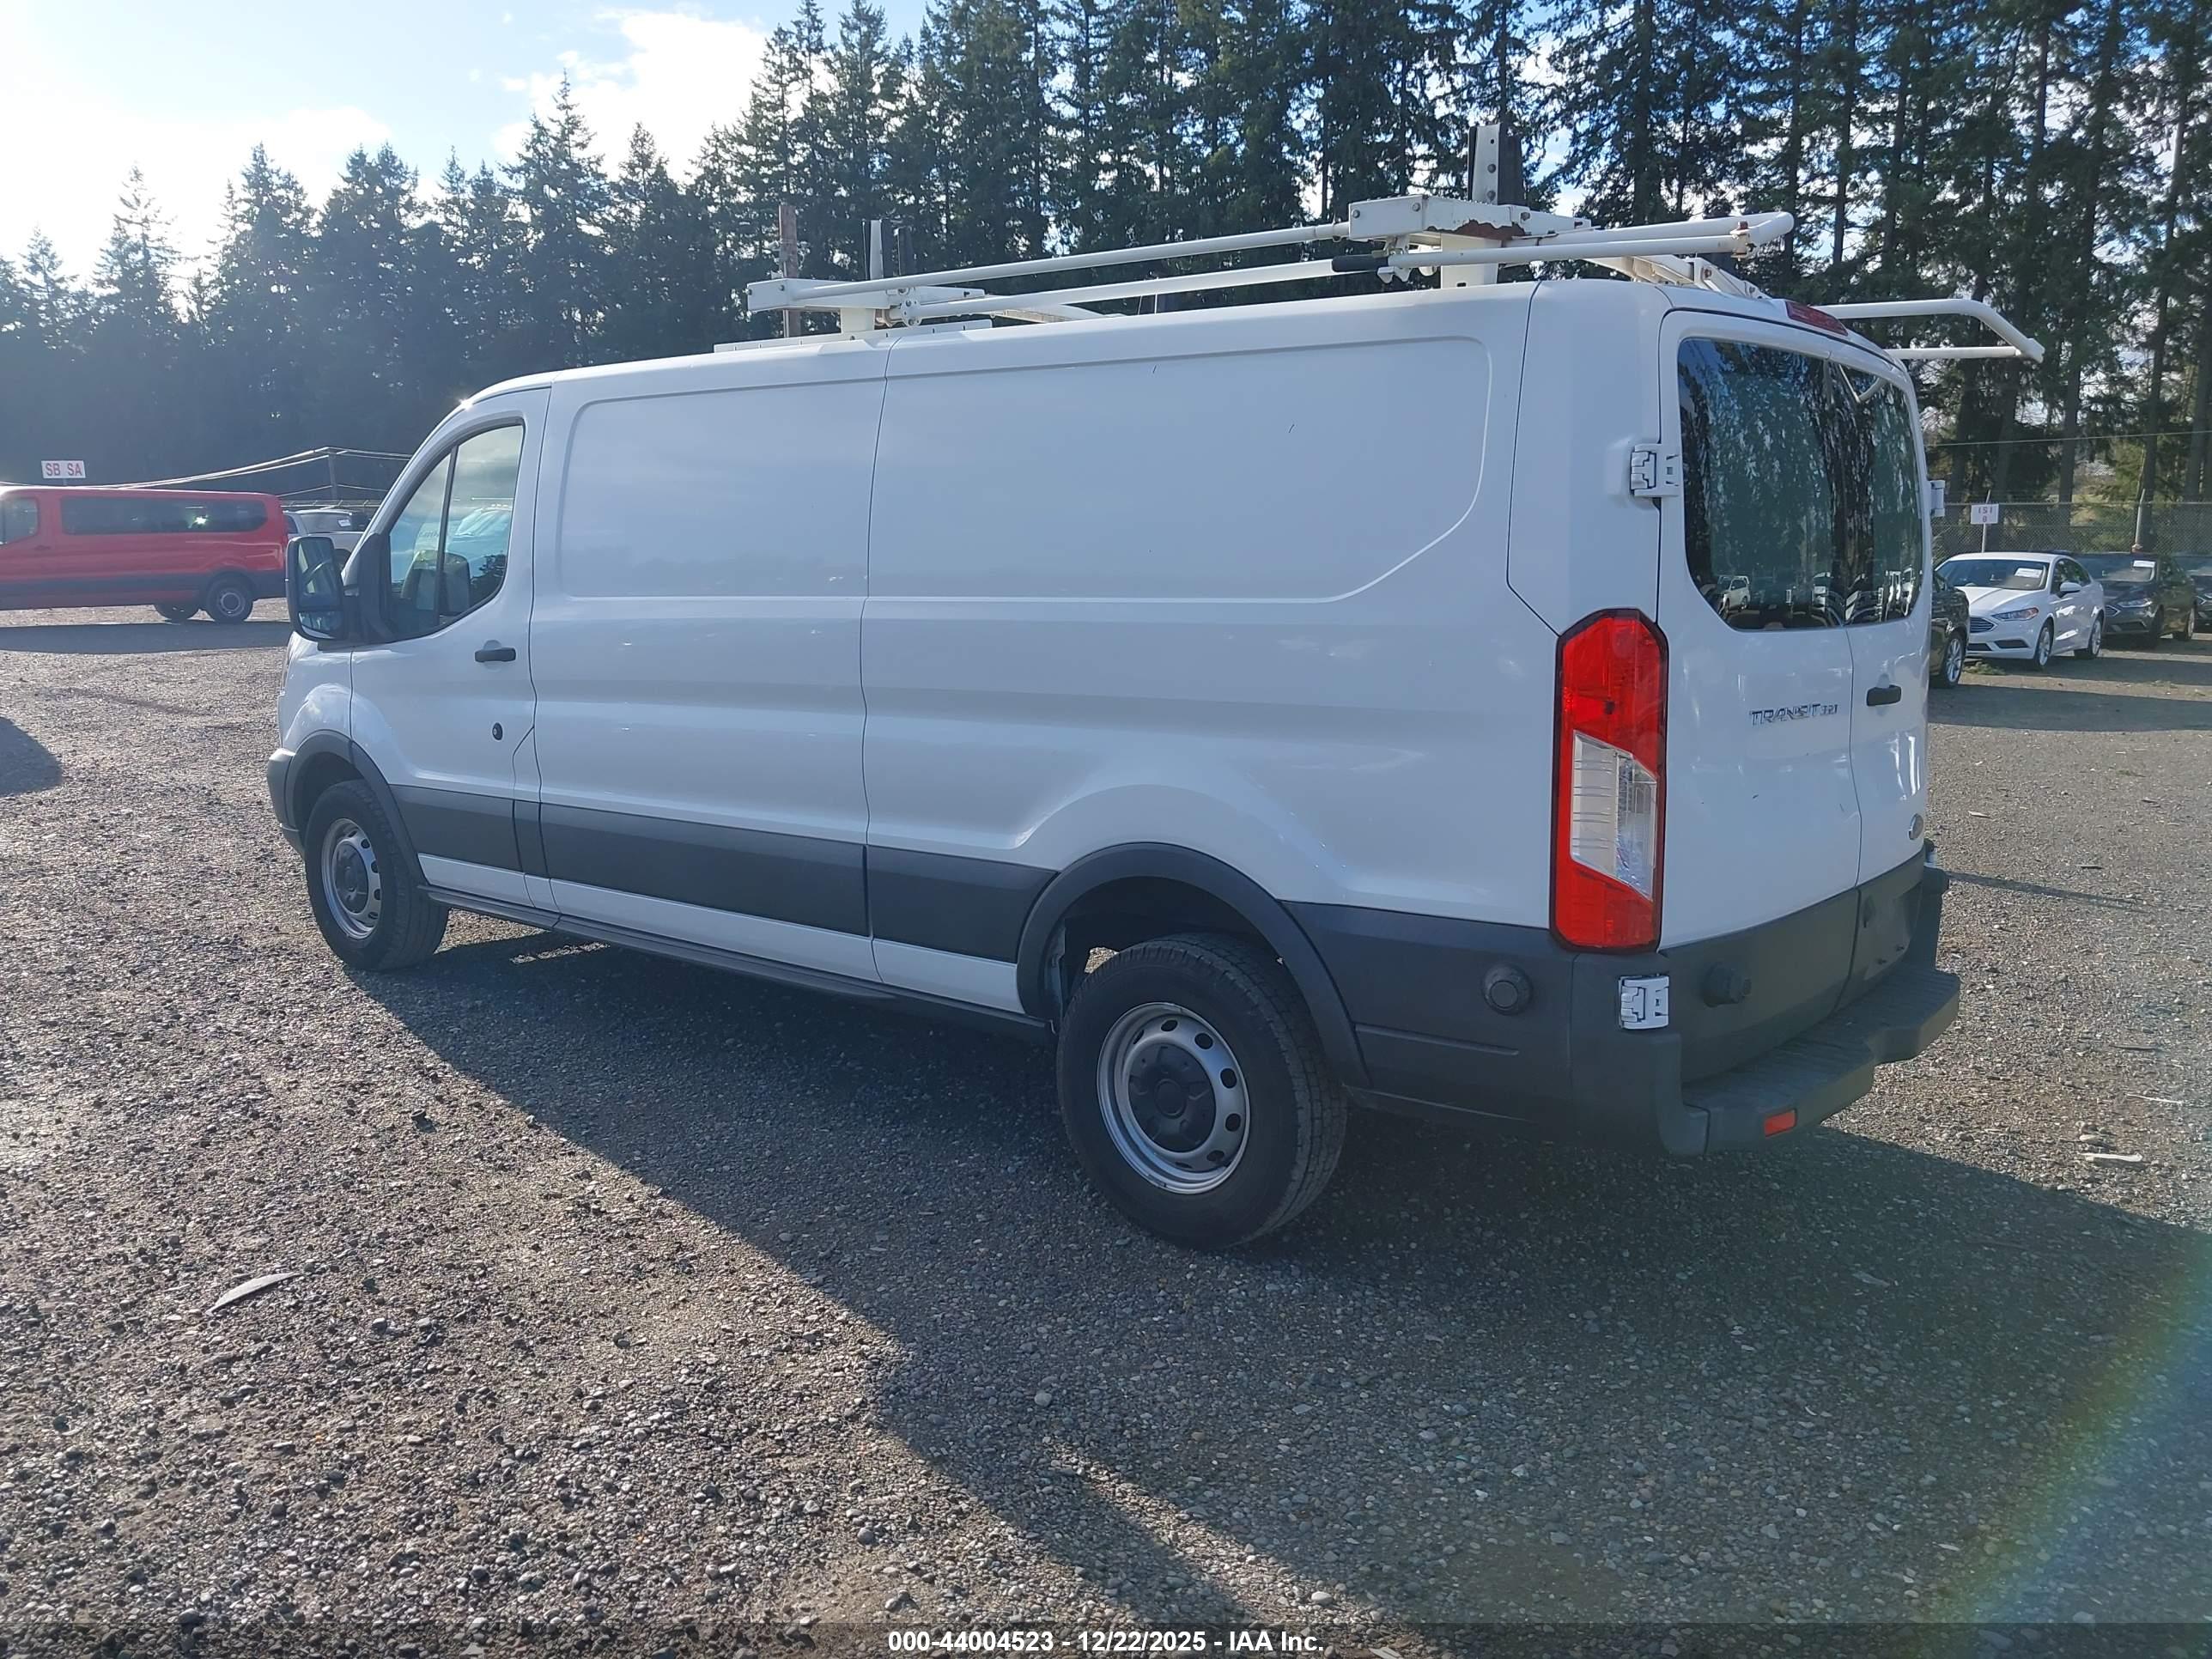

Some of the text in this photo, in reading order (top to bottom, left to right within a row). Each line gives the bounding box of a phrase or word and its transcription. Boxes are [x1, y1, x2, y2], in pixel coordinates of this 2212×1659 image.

[46, 463, 83, 477] SB SA
[1750, 703, 1821, 726] TRANSIT
